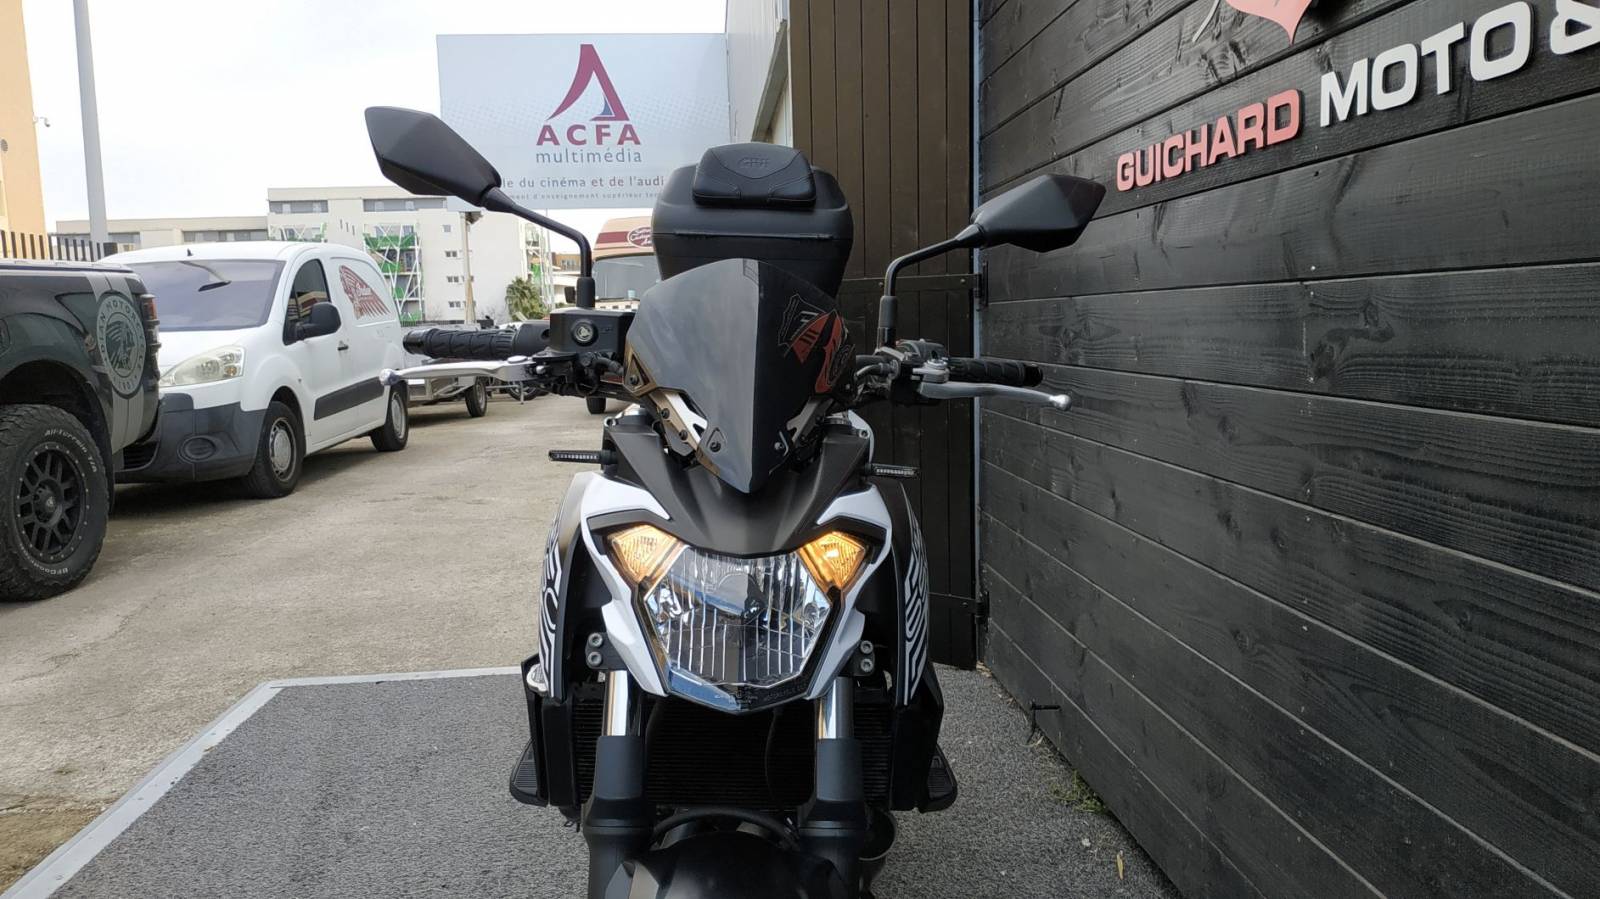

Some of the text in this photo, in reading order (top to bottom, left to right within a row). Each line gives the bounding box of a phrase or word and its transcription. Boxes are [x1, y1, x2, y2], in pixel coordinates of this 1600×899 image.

[1116, 89, 1302, 192] GUICHARD
[1320, 1, 1532, 127] MOTO
[536, 124, 642, 146] ACFA
[536, 148, 642, 163] multimédia
[519, 177, 535, 188] du
[540, 176, 586, 187] cinéma
[591, 177, 605, 187] et
[609, 176, 625, 187] de
[629, 176, 665, 187] l'audi
